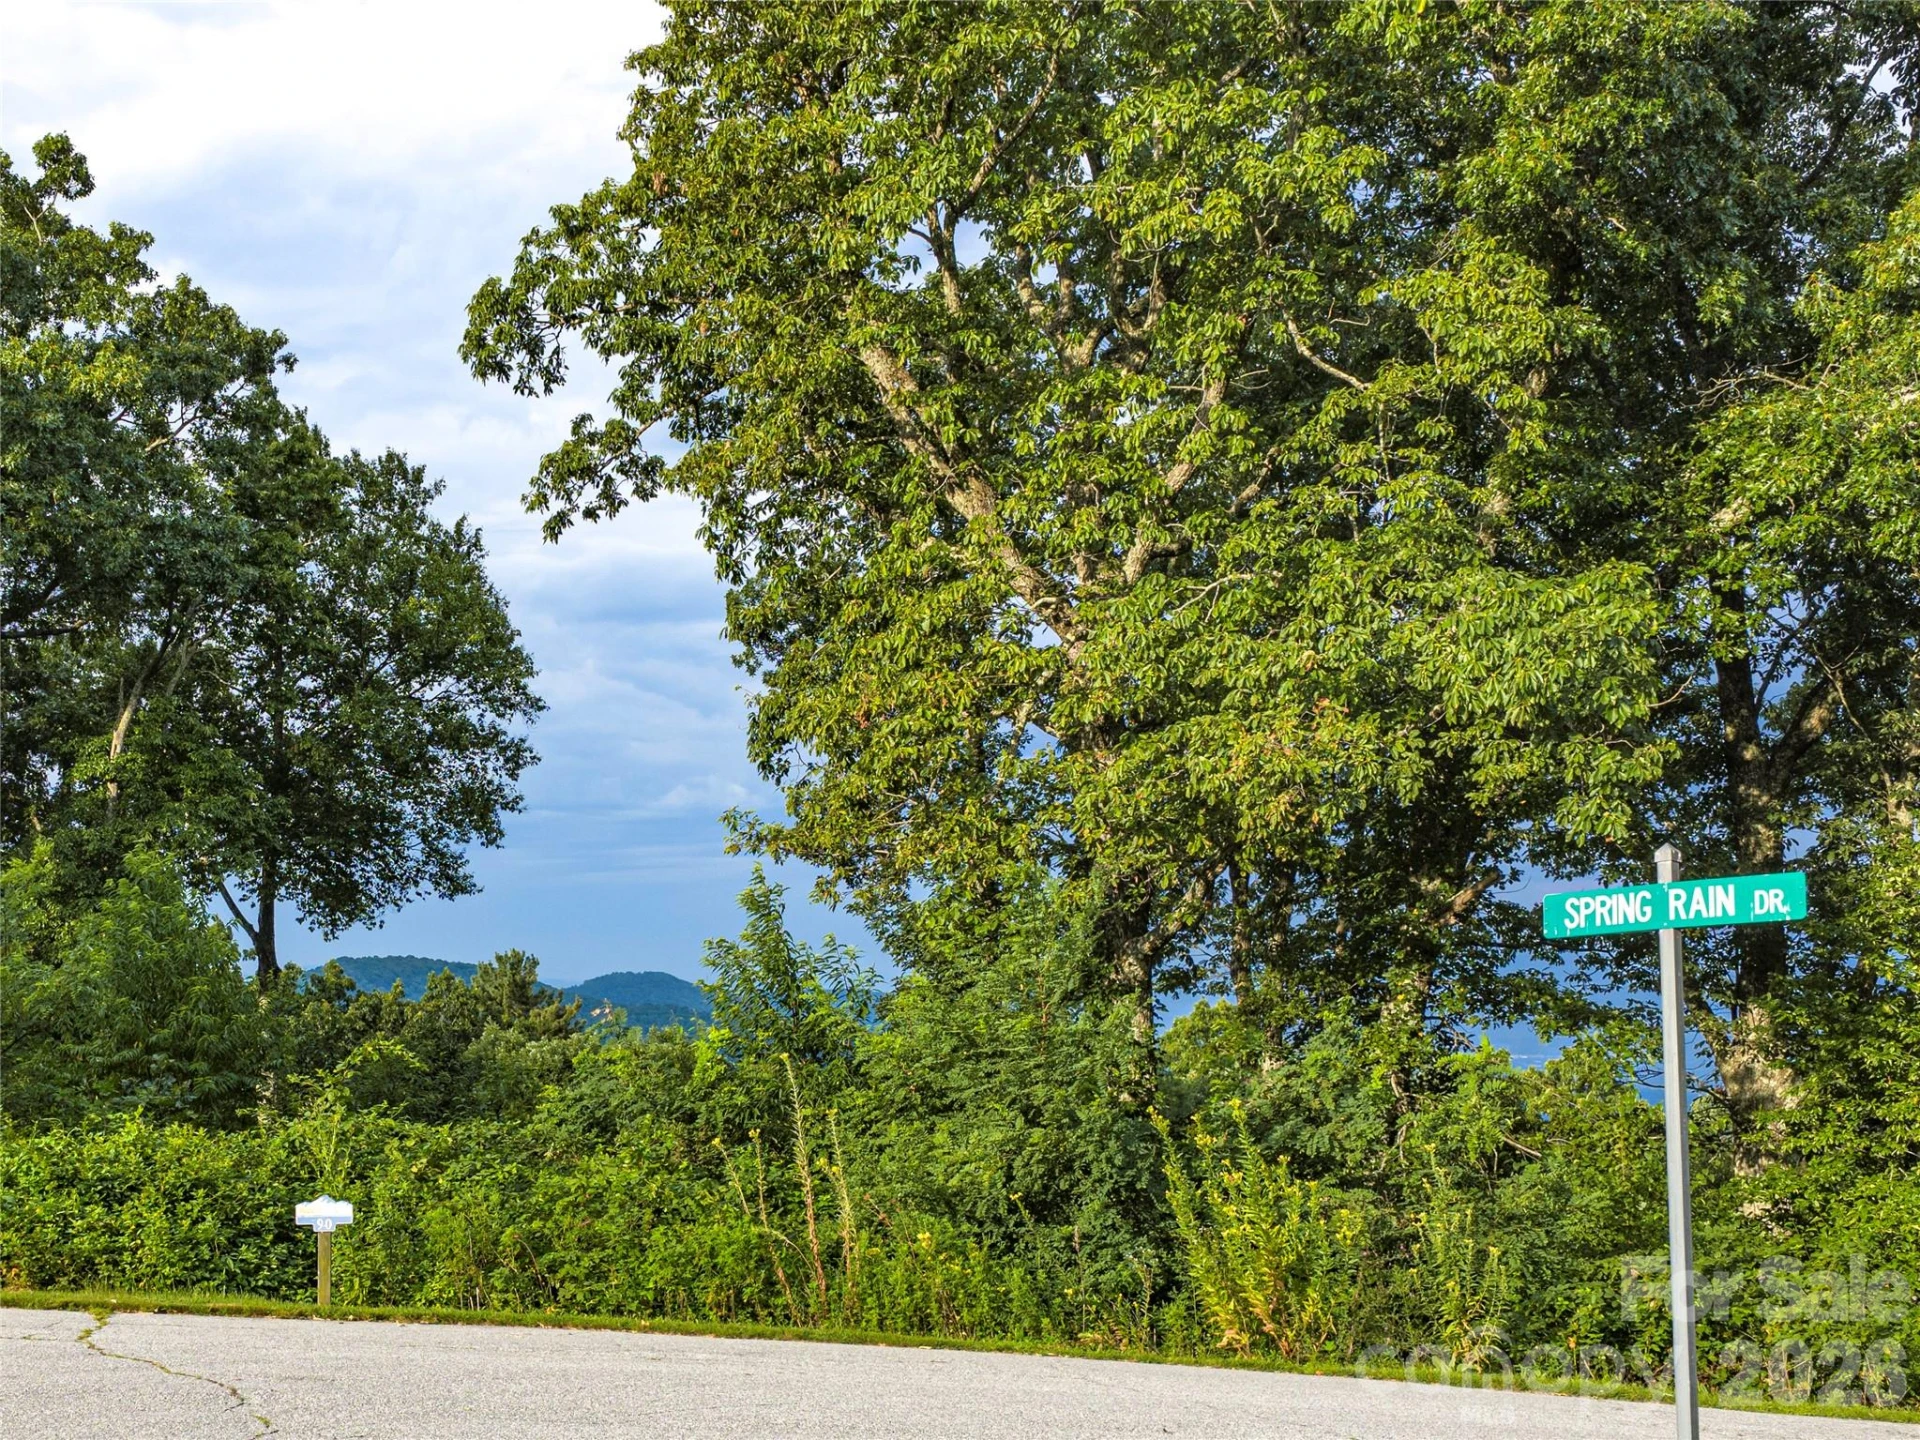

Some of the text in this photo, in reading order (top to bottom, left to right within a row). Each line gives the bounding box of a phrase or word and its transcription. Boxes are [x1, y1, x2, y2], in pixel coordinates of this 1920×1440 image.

[1564, 890, 1652, 930] SPRING
[1668, 884, 1736, 921] RAIN
[316, 1218, 333, 1231] 90
